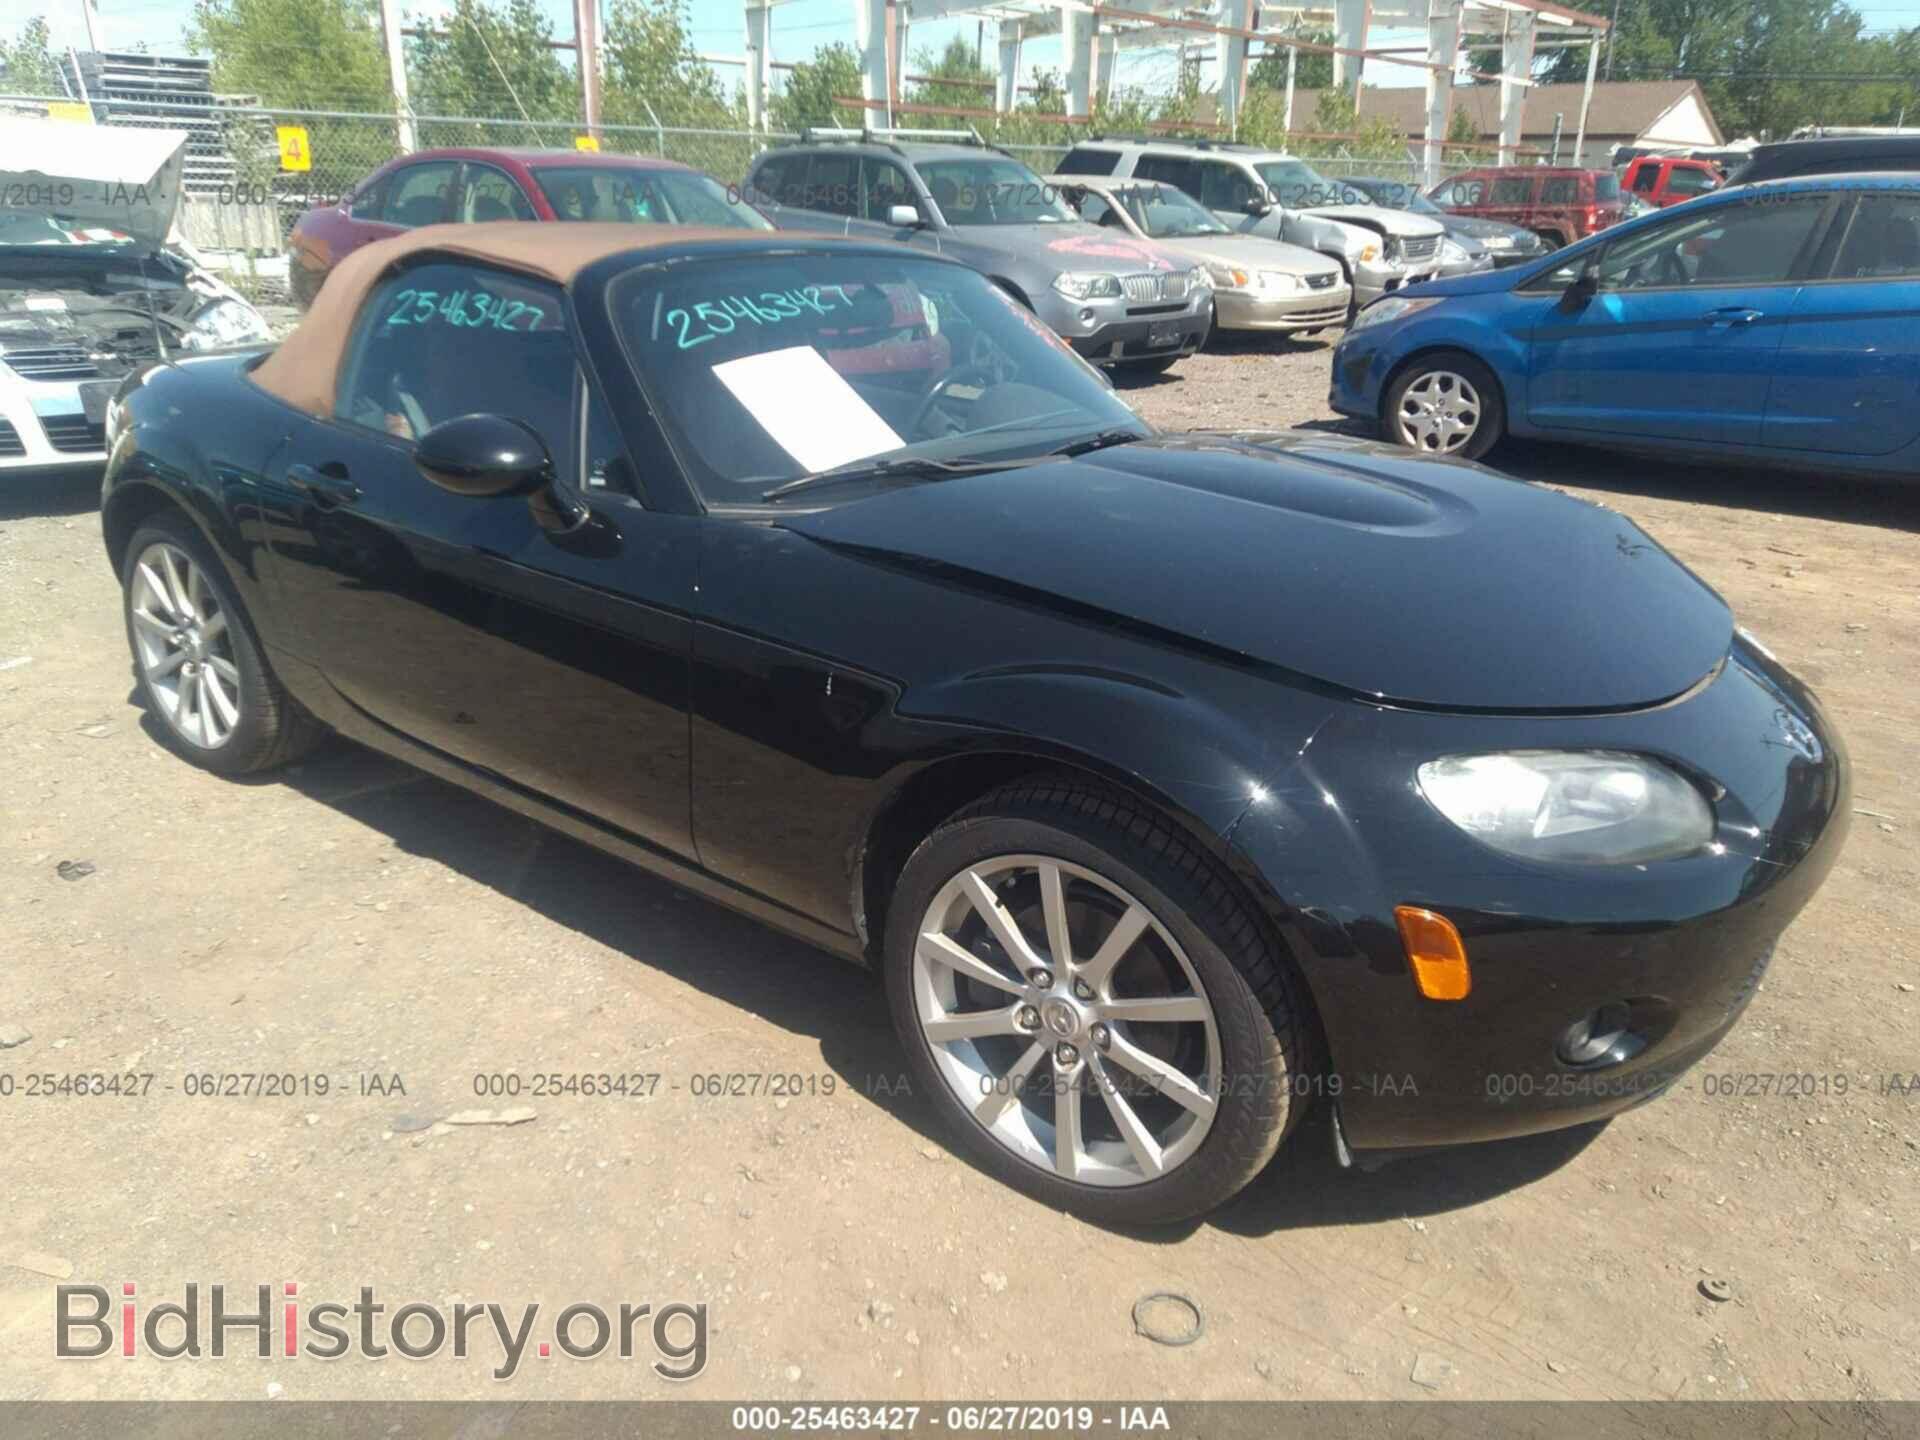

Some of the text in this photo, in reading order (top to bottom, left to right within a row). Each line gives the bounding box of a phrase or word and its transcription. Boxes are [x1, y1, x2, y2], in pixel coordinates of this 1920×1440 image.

[286, 136, 302, 161] 4
[387, 288, 544, 332] 25463427
[667, 285, 853, 348] 25463427
